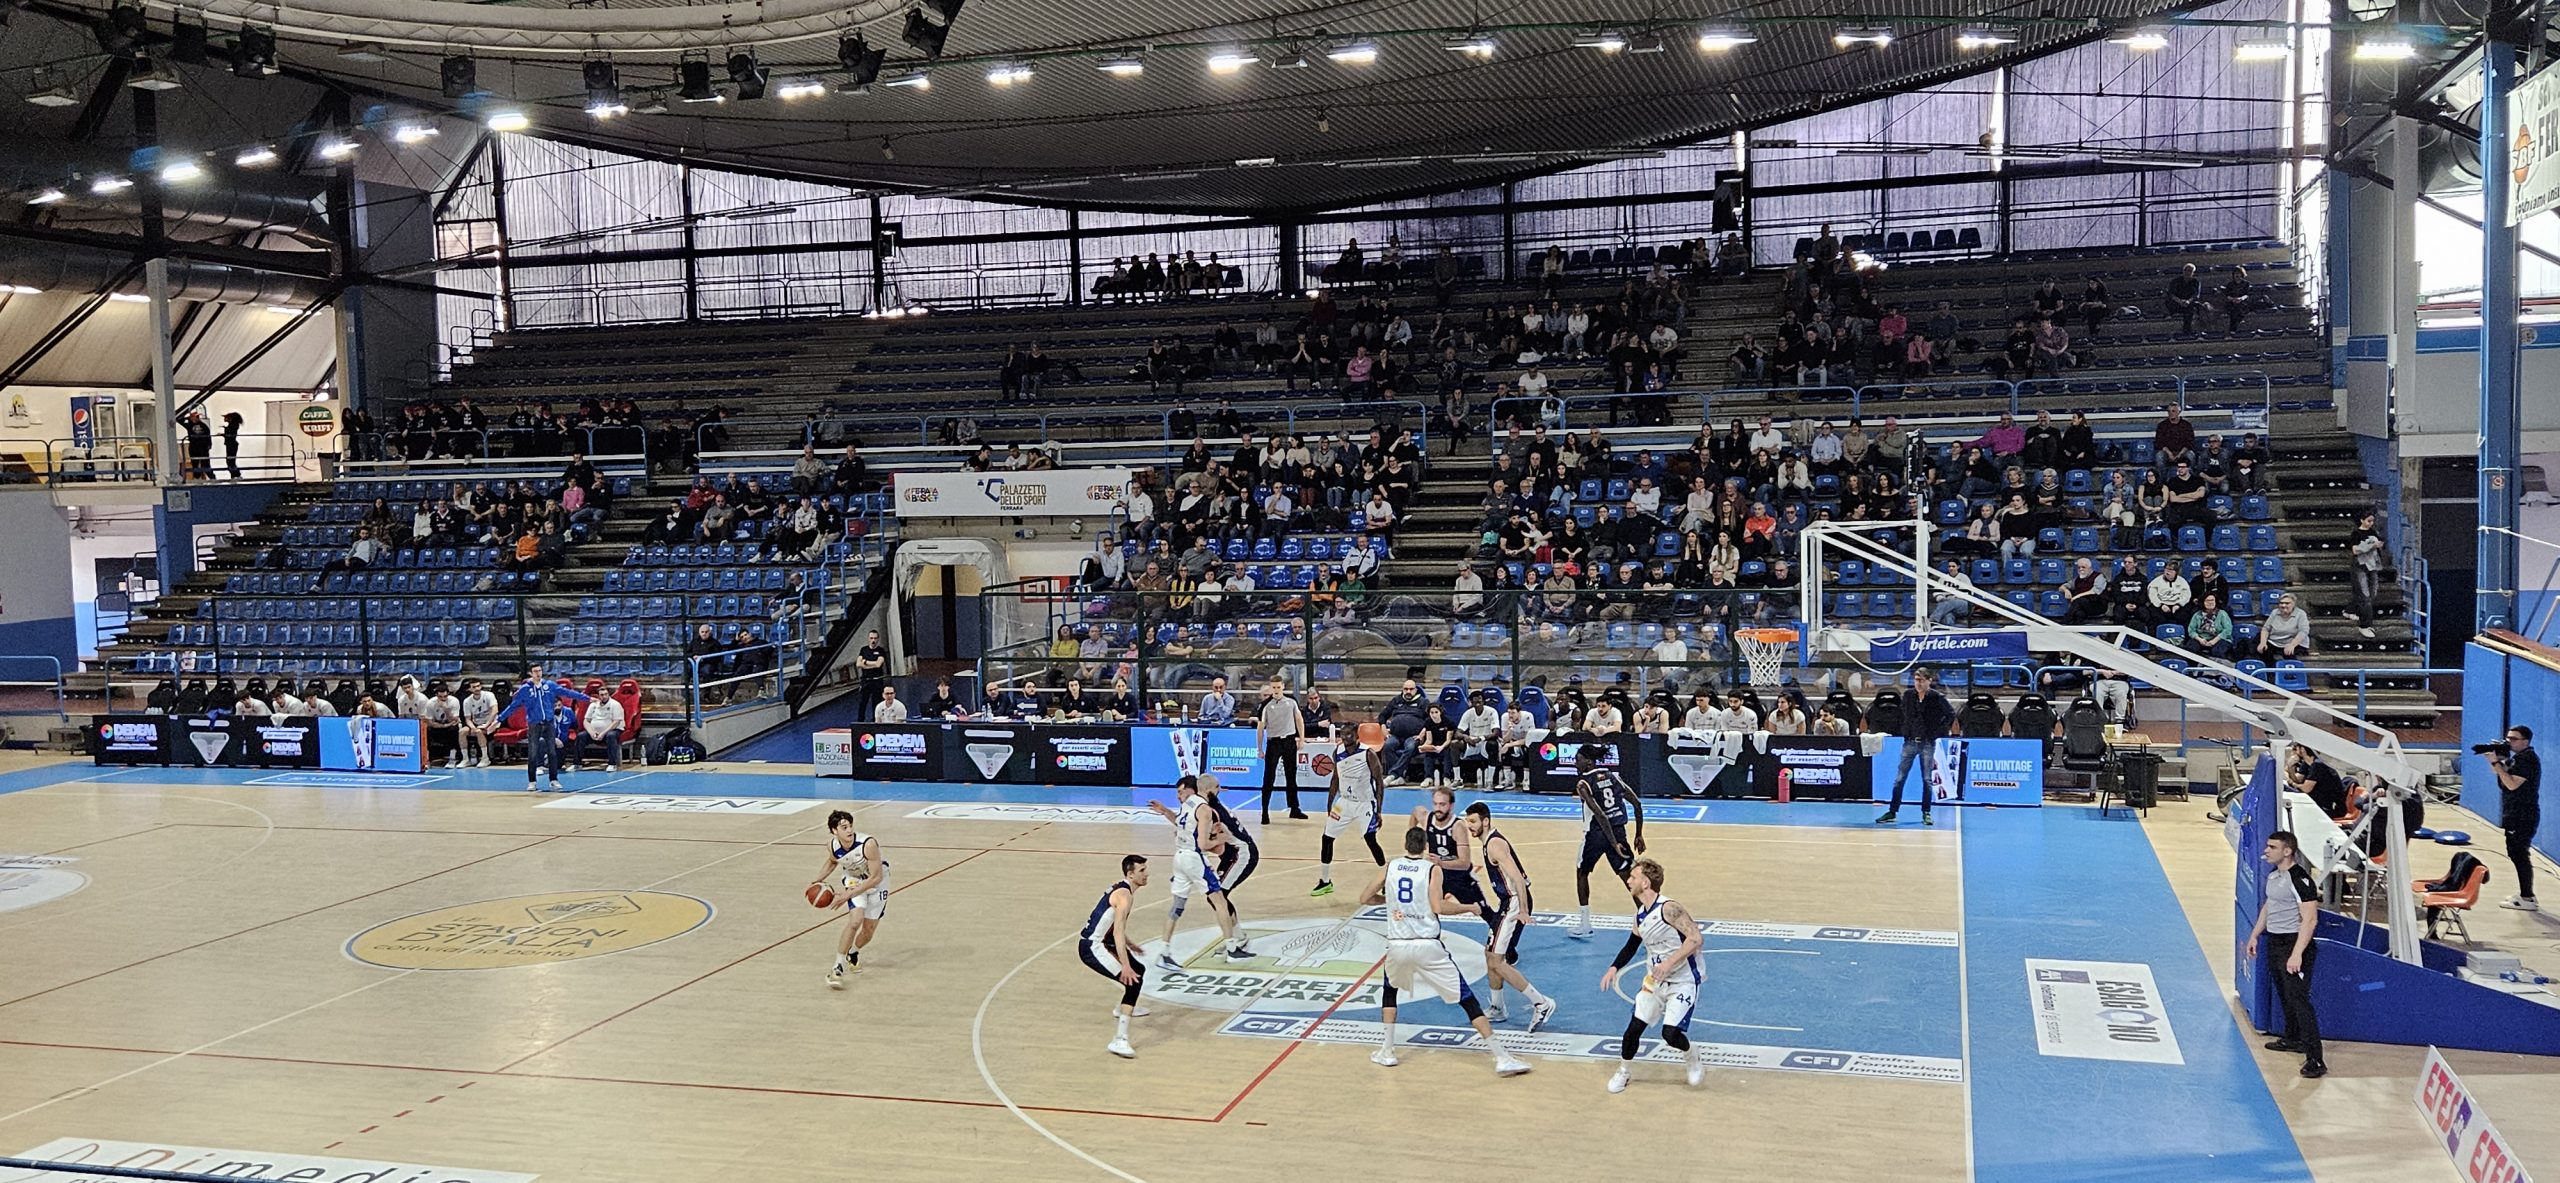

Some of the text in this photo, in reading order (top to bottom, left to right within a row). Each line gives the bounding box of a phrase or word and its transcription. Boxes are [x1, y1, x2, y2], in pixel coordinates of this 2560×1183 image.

[1000, 485, 1046, 496] PALAZZETTO
[1000, 495, 1046, 506] DELLO SPORT
[1910, 637, 1988, 651] bertele.com
[114, 724, 157, 736] DEDEM
[875, 734, 925, 747] DEDEM
[816, 743, 850, 753] LEGA
[1211, 747, 1227, 757] FOTO
[1068, 756, 1106, 766] DEDEM
[1971, 760, 2032, 772] FOTO VINTAGE
[1794, 768, 1841, 780] DEDEM
[1347, 785, 1352, 794] 4
[1603, 788, 1615, 808] 8
[1436, 834, 1447, 846] 11
[1398, 877, 1414, 903] 8
[427, 923, 628, 938] STAGIONI
[1823, 930, 1861, 938] CFI
[397, 931, 594, 949] D'ITALIA
[1157, 983, 1378, 1005] FERRARA
[2096, 980, 2161, 1043] ESAGONO
[1243, 1020, 1286, 1031] CFI
[1422, 1031, 1465, 1042] CFI
[1793, 1055, 1840, 1066] CFI
[1857, 1054, 1916, 1063] Centro
[1848, 1066, 1960, 1079] Innovazione
[1852, 1060, 1959, 1073] Formazione
[2423, 1061, 2462, 1134] ETES
[112, 1149, 472, 1183] Dimedi
